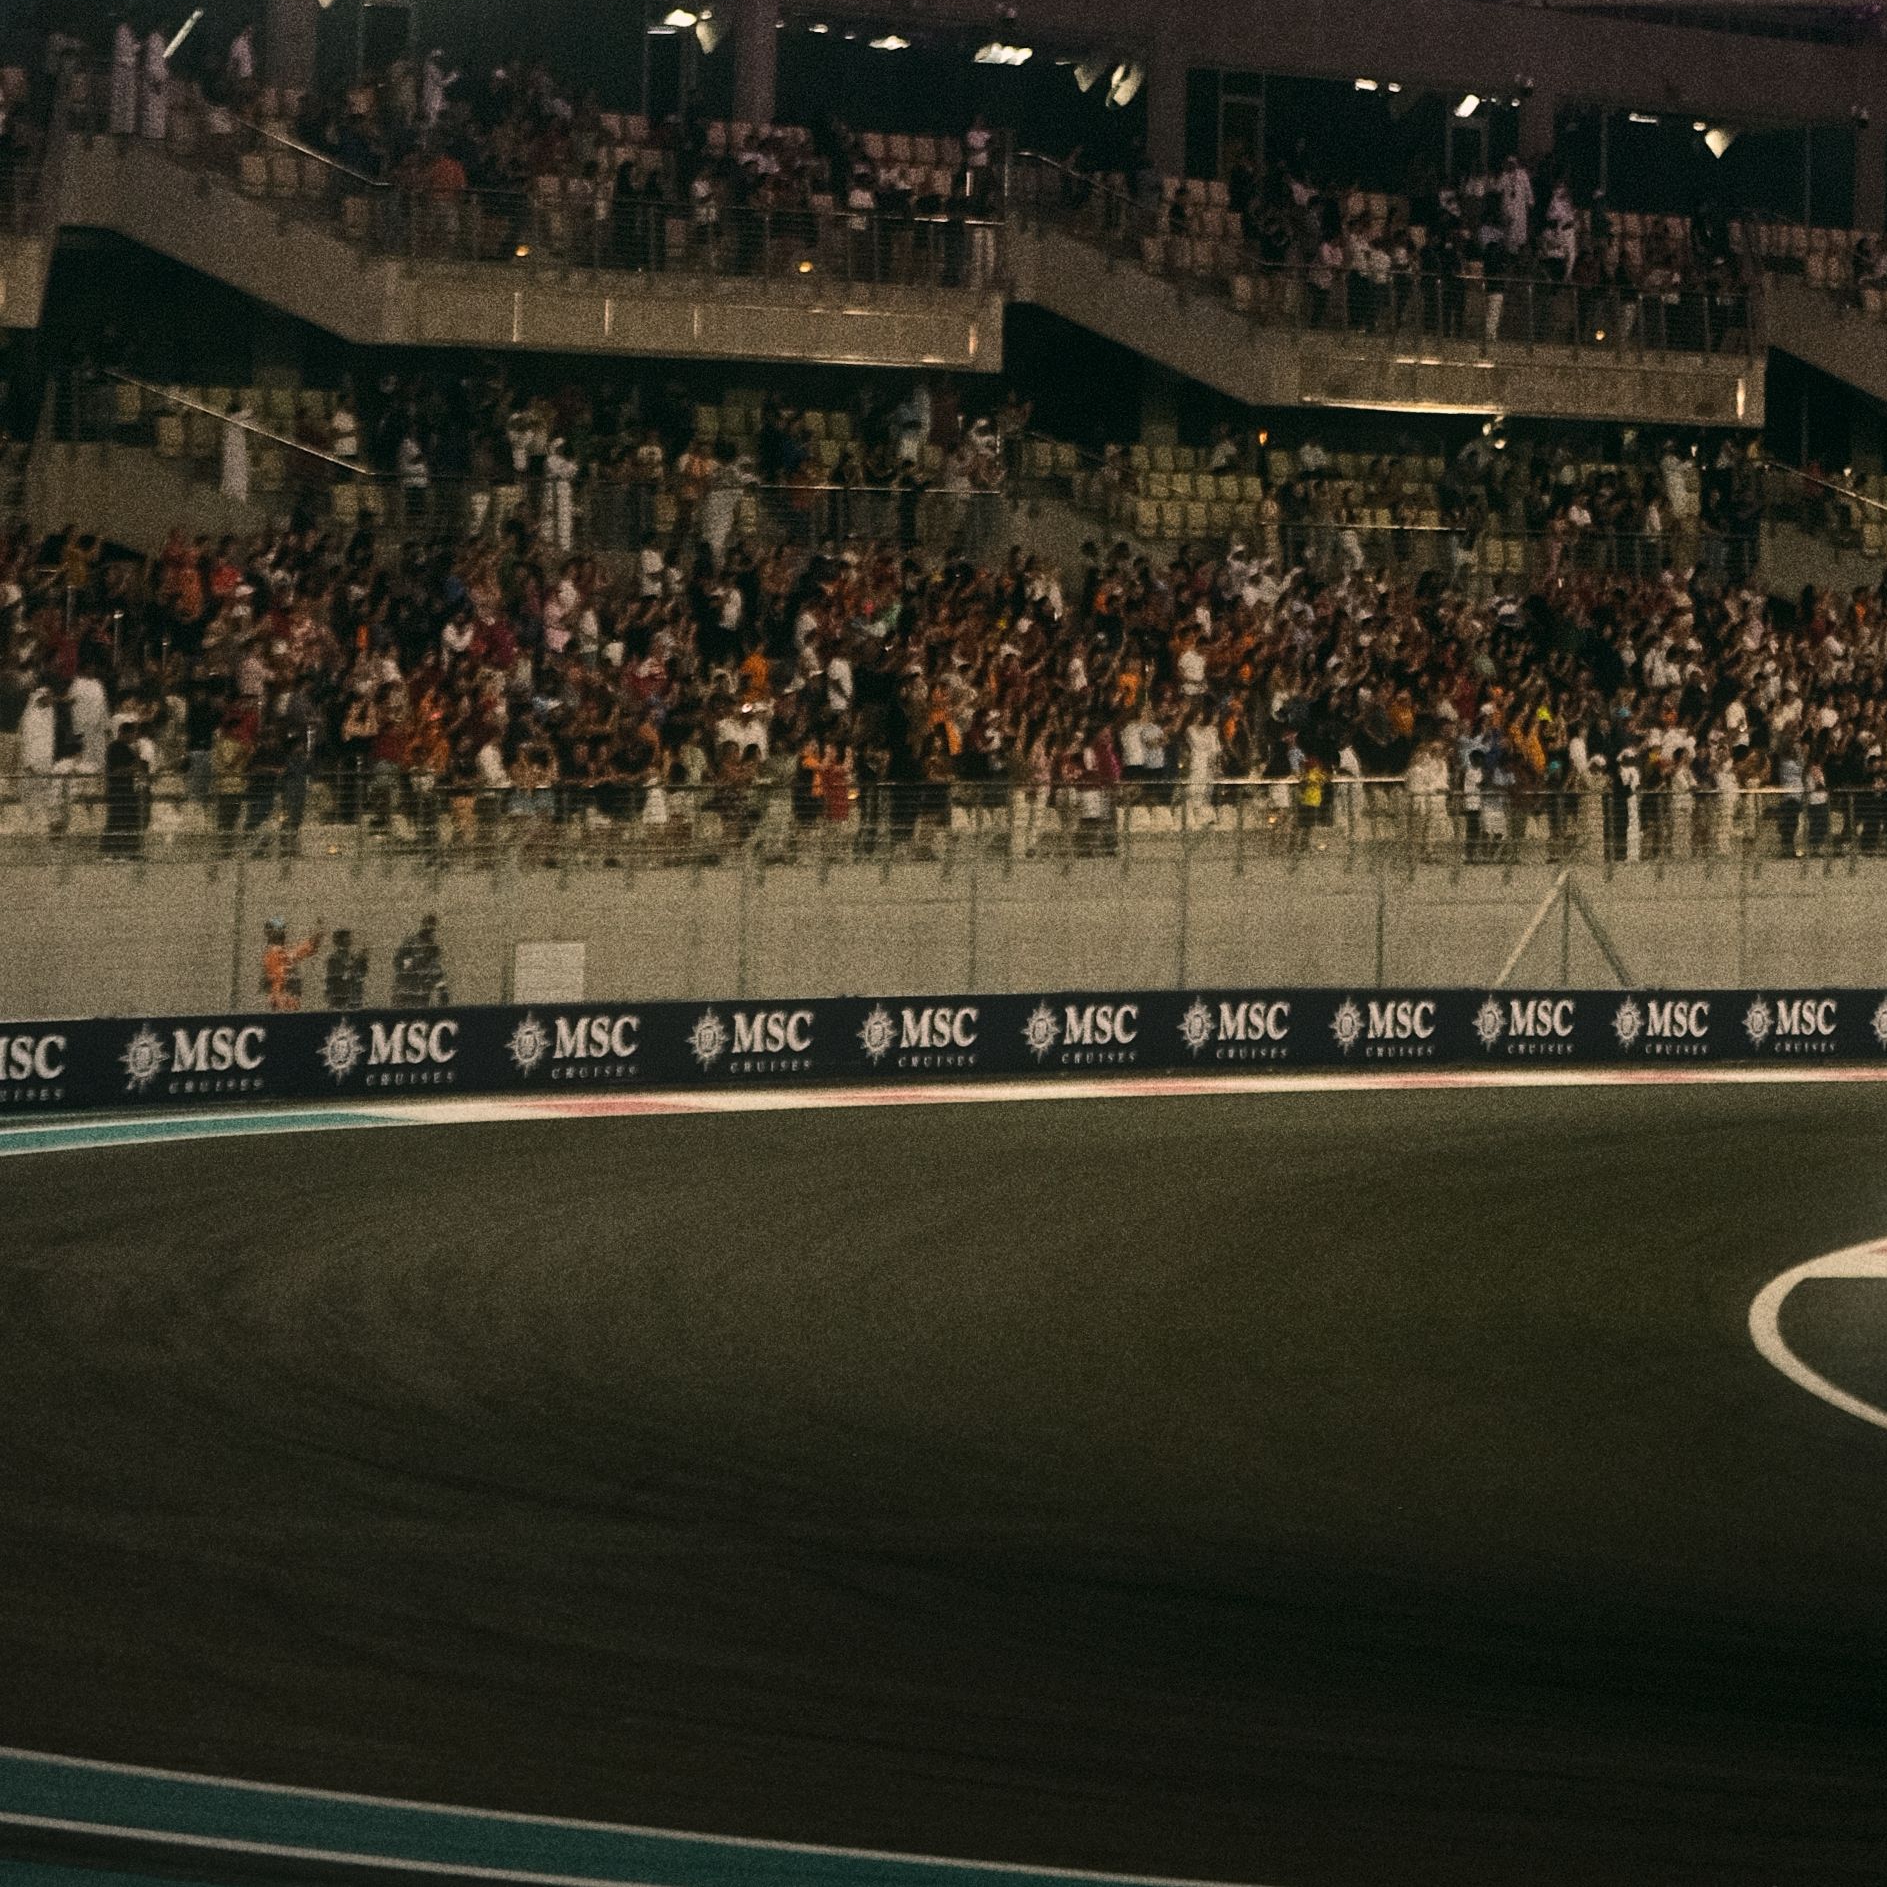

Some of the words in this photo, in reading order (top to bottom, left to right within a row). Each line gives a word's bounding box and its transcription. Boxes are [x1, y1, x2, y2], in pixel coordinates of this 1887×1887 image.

[553, 1015, 639, 1059] MSC
[732, 1010, 813, 1053] MSC
[900, 1007, 978, 1048] MSC
[1063, 1004, 1138, 1045] MSC
[1218, 1001, 1289, 1041] MSC
[1367, 1001, 1435, 1039] MSC
[1509, 999, 1574, 1037] MSC
[1646, 1001, 1709, 1038] MSC
[1775, 999, 1836, 1035] MSC
[0, 1035, 66, 1080] SC
[171, 1026, 265, 1072] MSC
[368, 1020, 458, 1065] MSC
